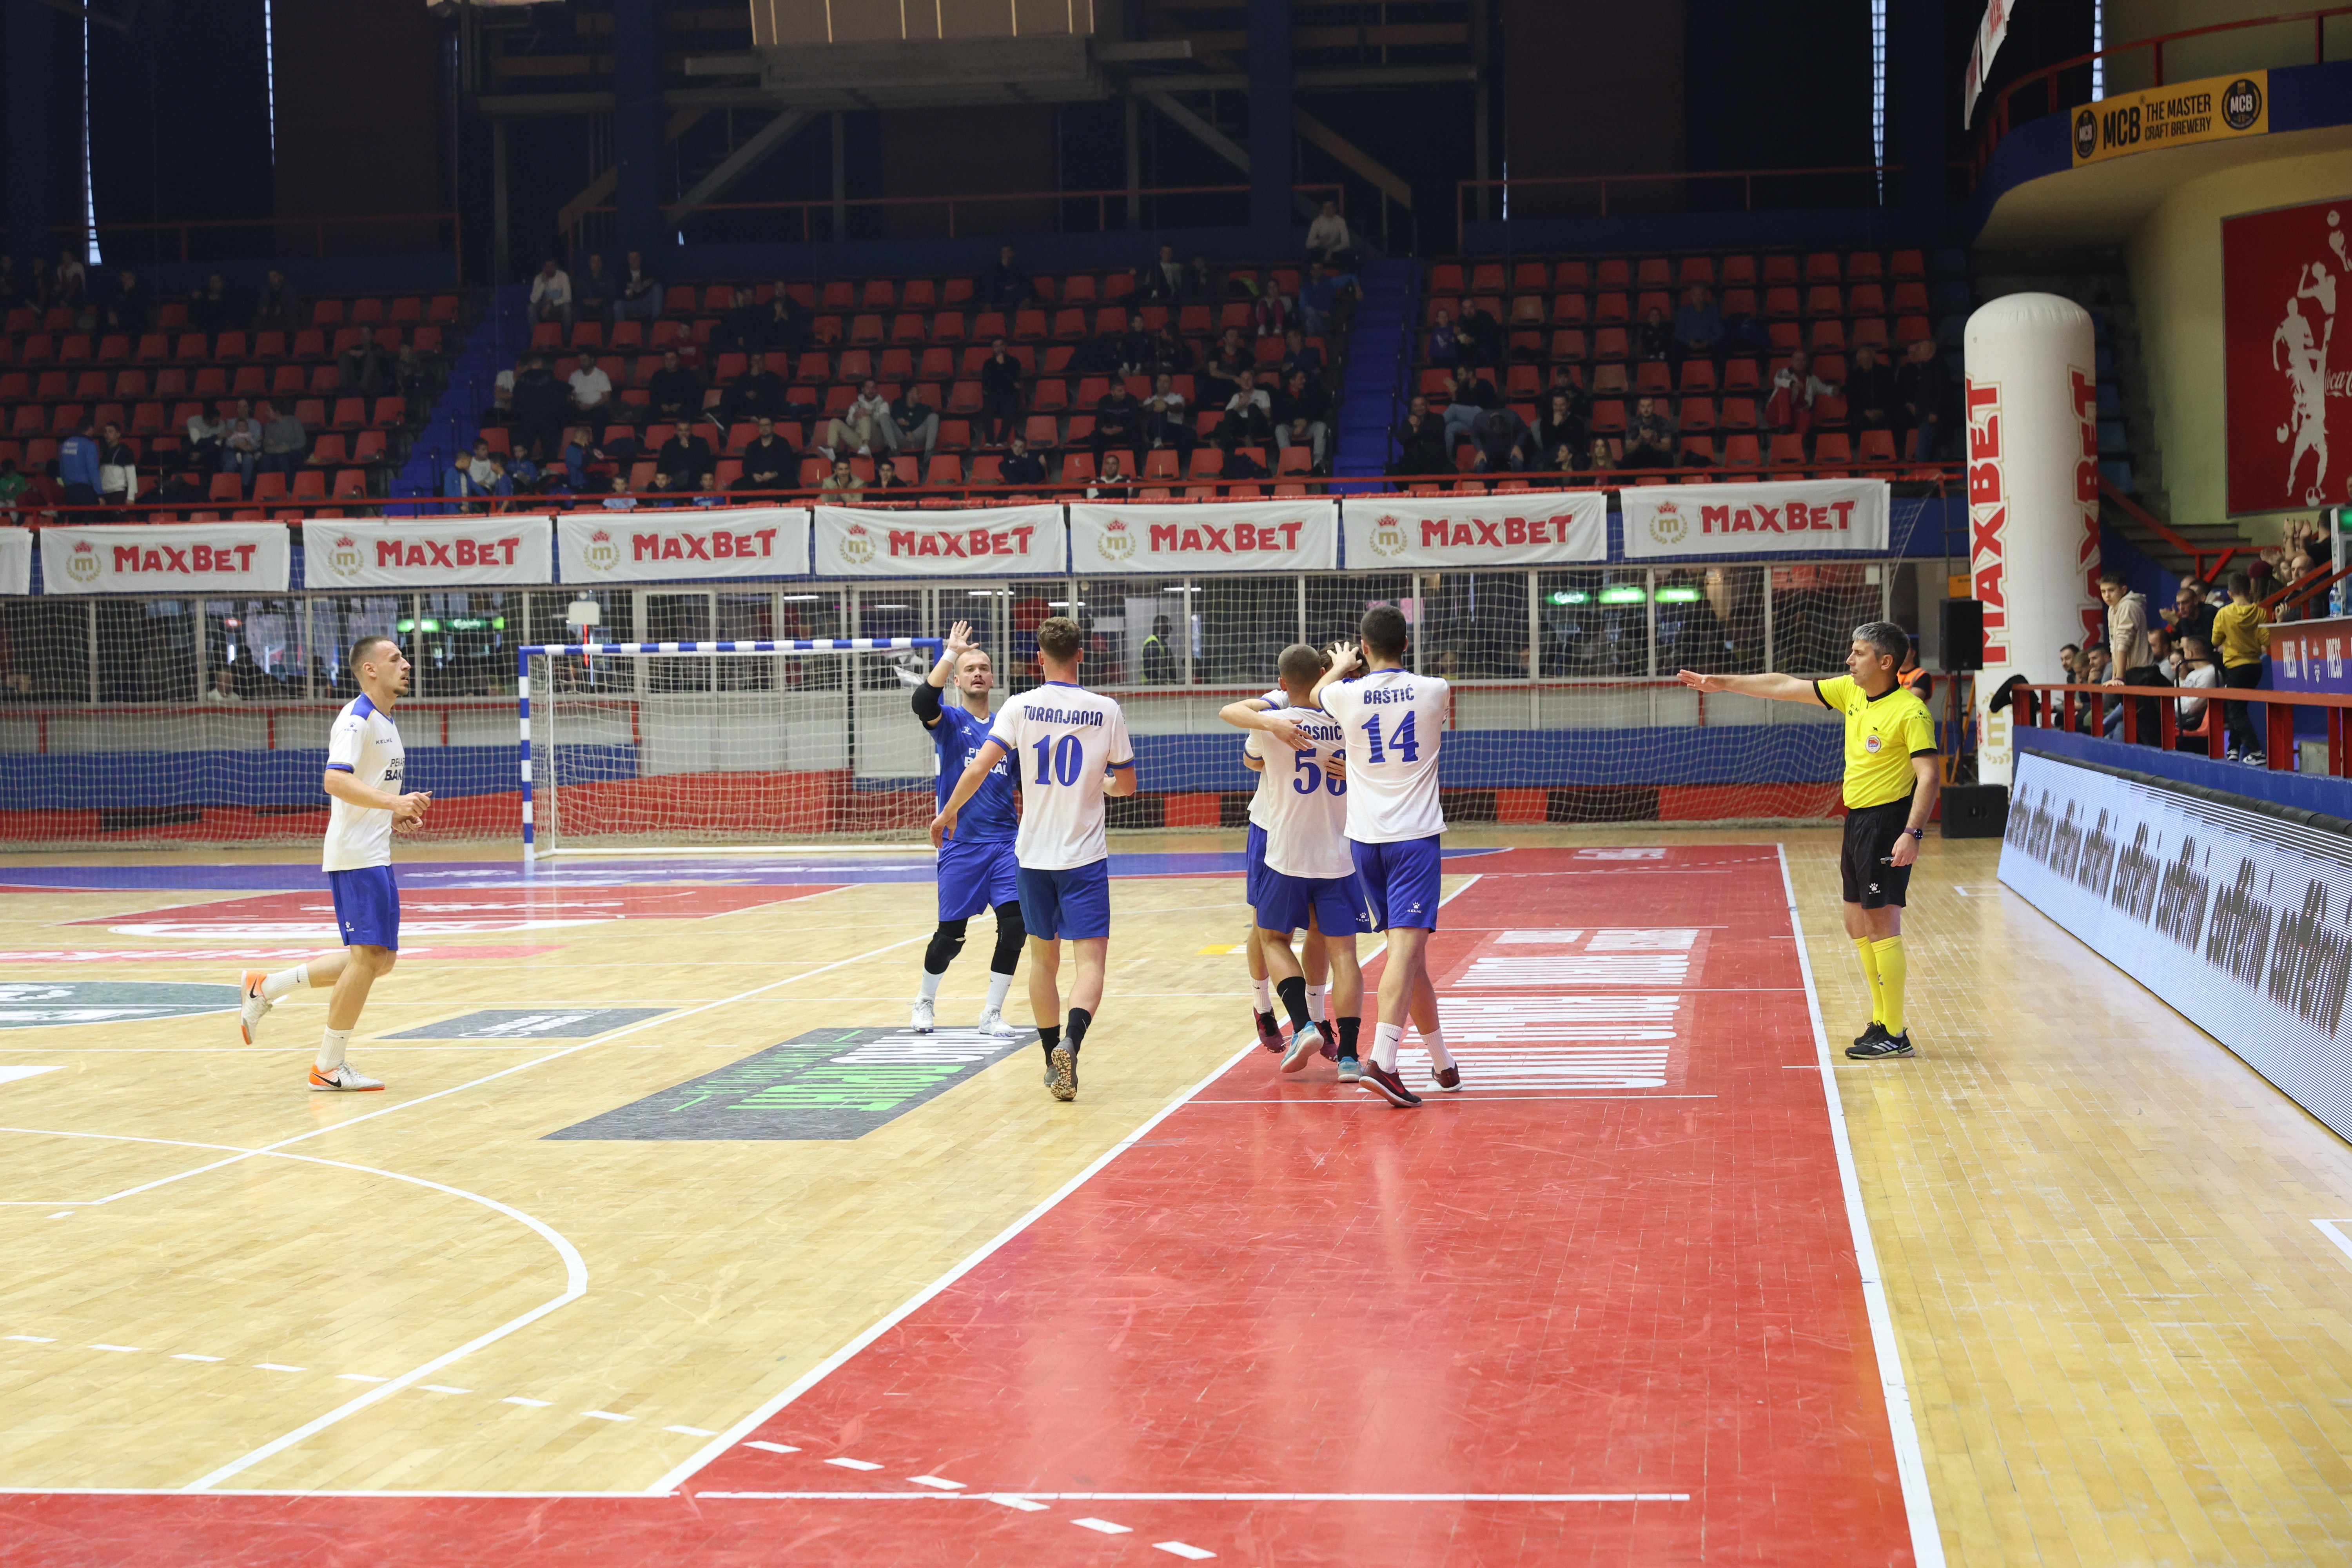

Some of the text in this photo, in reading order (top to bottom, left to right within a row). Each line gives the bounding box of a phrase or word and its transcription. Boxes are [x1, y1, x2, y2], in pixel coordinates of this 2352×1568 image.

[2146, 94, 2211, 122] THE MASTER
[2230, 94, 2252, 114] MCB
[2103, 107, 2141, 149] MCB
[2145, 116, 2211, 141] CRAFT BREWERY
[1421, 514, 1573, 547] MAXBET
[1701, 501, 1855, 533] MAXBET
[376, 537, 521, 568] MAXBET
[632, 528, 777, 561] MAXBET
[888, 525, 1034, 558] MAXBET
[1150, 522, 1303, 553] MAXBET
[113, 544, 257, 573] MAXBET
[2326, 637, 2343, 679] PRESS
[1363, 684, 1415, 705] BAŠTIĆ
[1024, 705, 1103, 727] TURANJANIN
[1361, 710, 1419, 764] 14
[1032, 734, 1083, 787] 10
